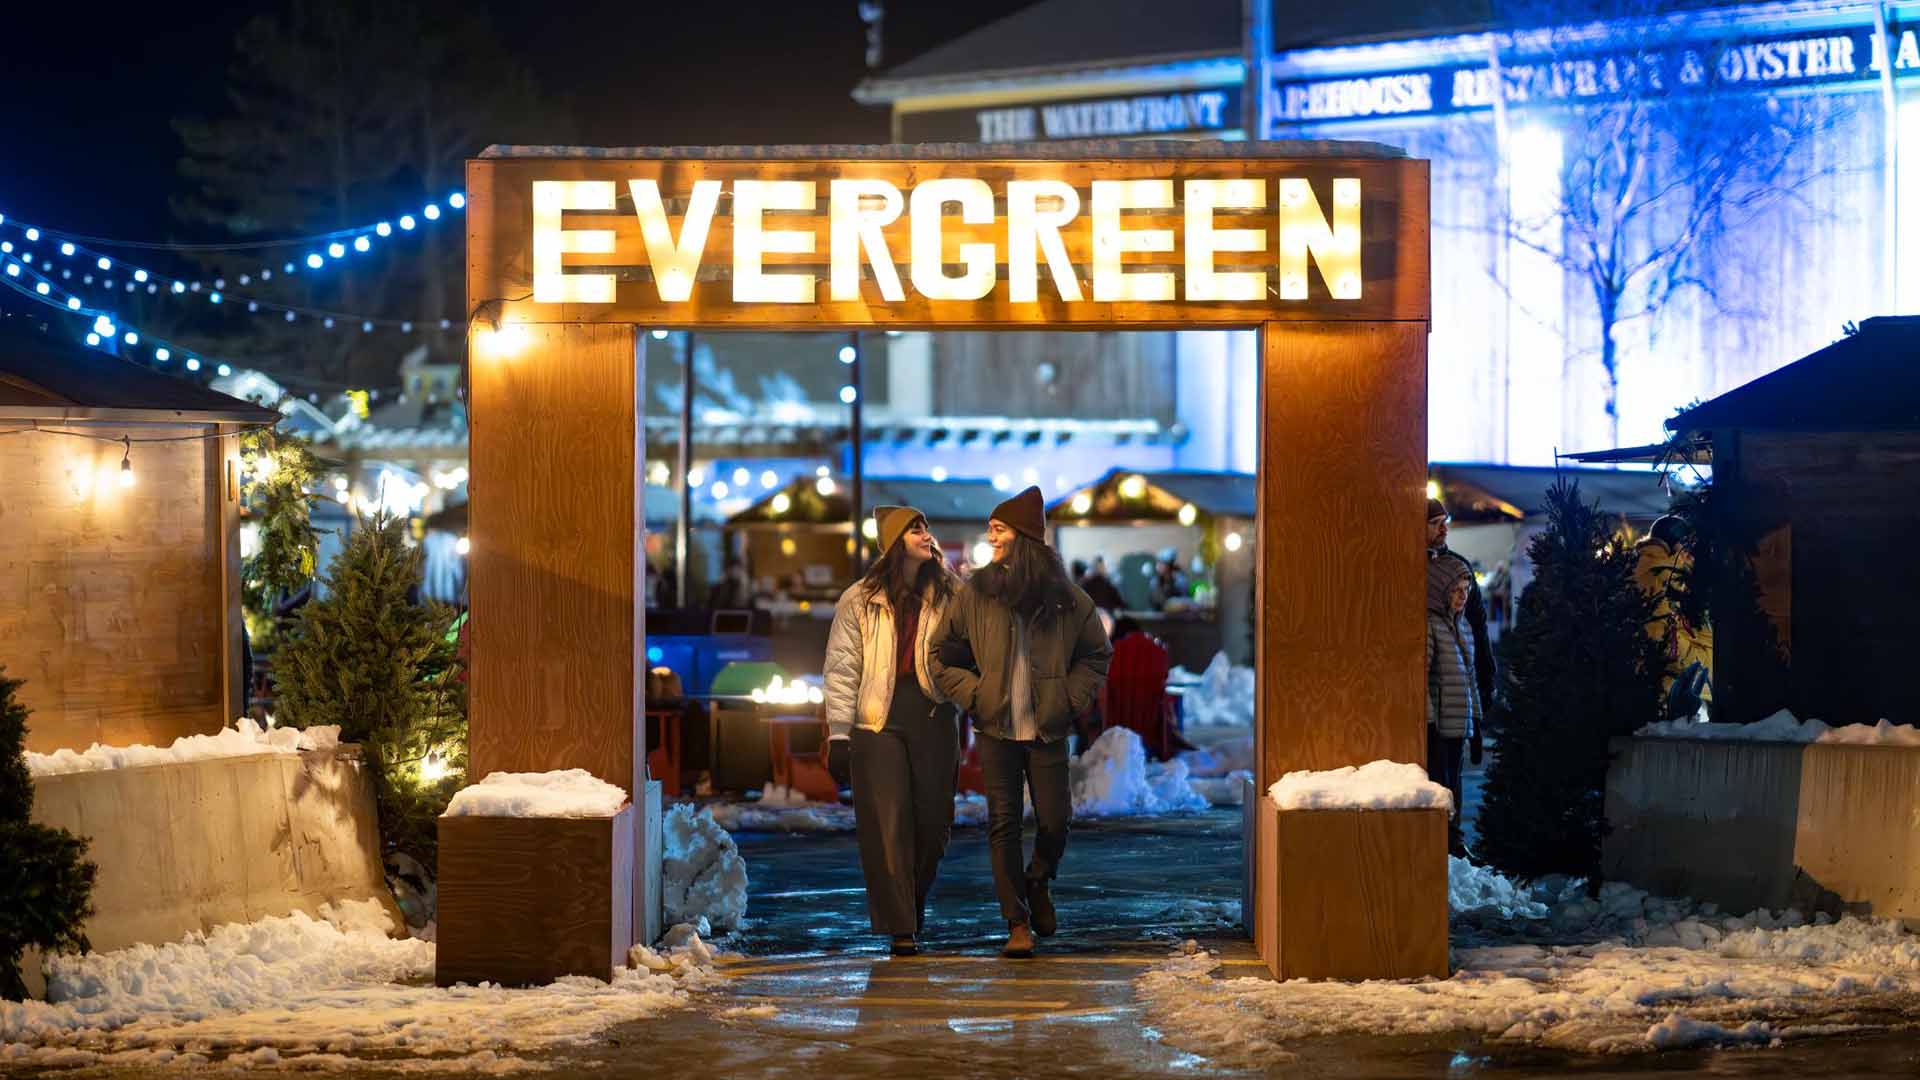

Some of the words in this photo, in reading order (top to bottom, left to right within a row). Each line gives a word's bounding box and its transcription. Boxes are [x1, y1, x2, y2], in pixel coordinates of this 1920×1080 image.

[977, 107, 1036, 143] THE
[1041, 92, 1226, 137] WATERFRONT
[1271, 73, 1432, 119] AREHOUSE
[1719, 36, 1856, 82] OYSTER
[532, 178, 1362, 303] EVERGREEN
